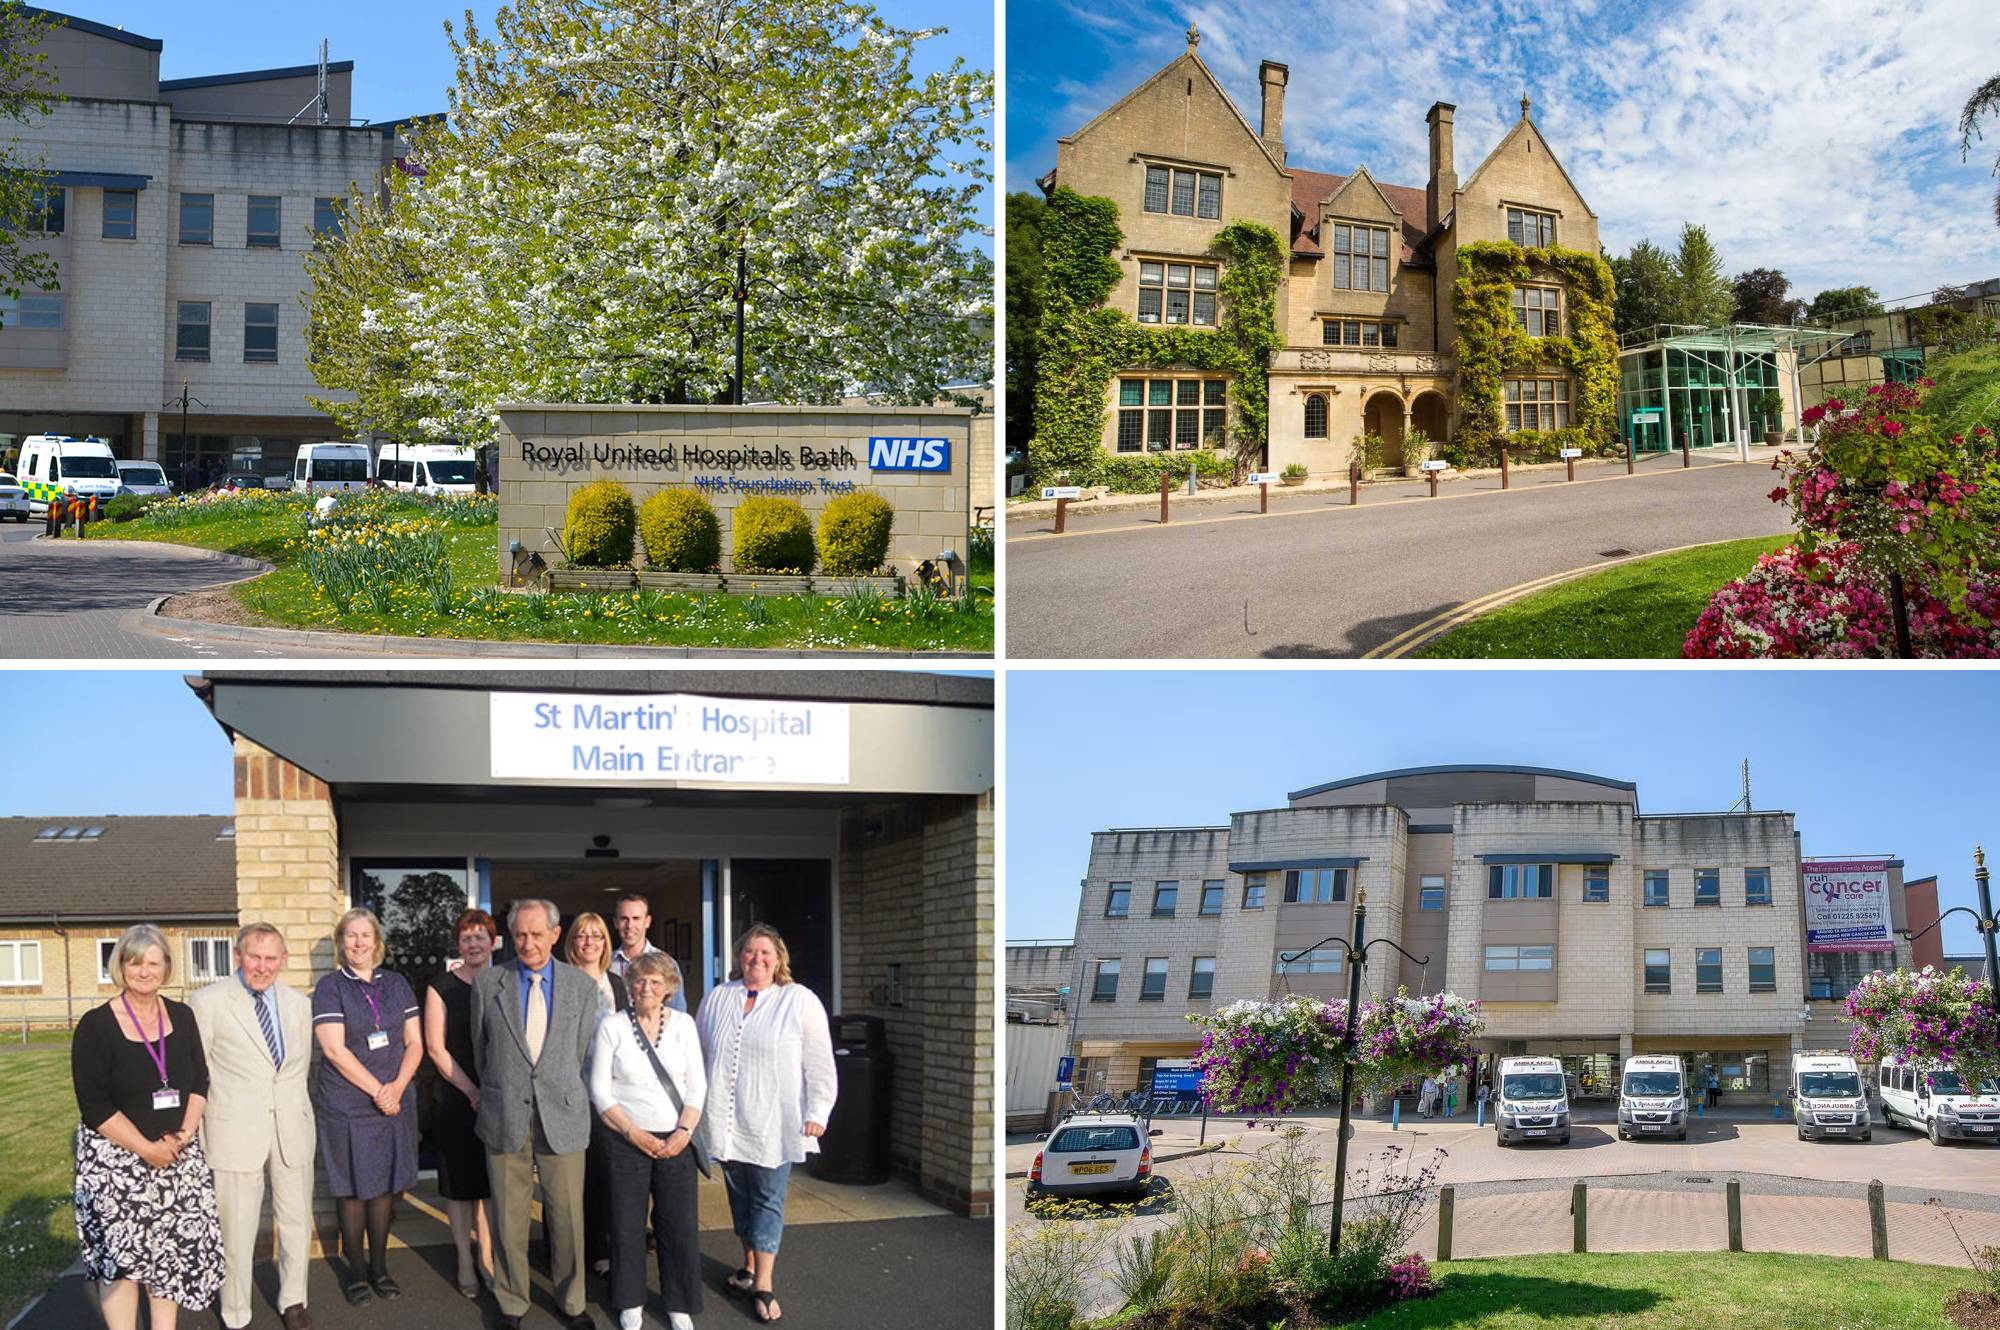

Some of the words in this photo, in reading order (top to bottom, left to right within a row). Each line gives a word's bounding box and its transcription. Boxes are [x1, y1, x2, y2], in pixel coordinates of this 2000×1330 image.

[522, 442, 583, 467] Royal
[594, 442, 673, 463] United
[683, 444, 791, 469] Hospitals
[800, 445, 854, 466] Bath
[871, 440, 945, 468] NHS
[694, 476, 723, 489] NHS
[729, 476, 813, 491] Foundation
[817, 477, 853, 491] Trust
[534, 703, 562, 729] St
[573, 702, 691, 731] Martin'
[702, 706, 811, 741] Hospital
[572, 744, 645, 772] Main
[658, 746, 776, 775] Entra
[1809, 874, 1828, 882] ruh
